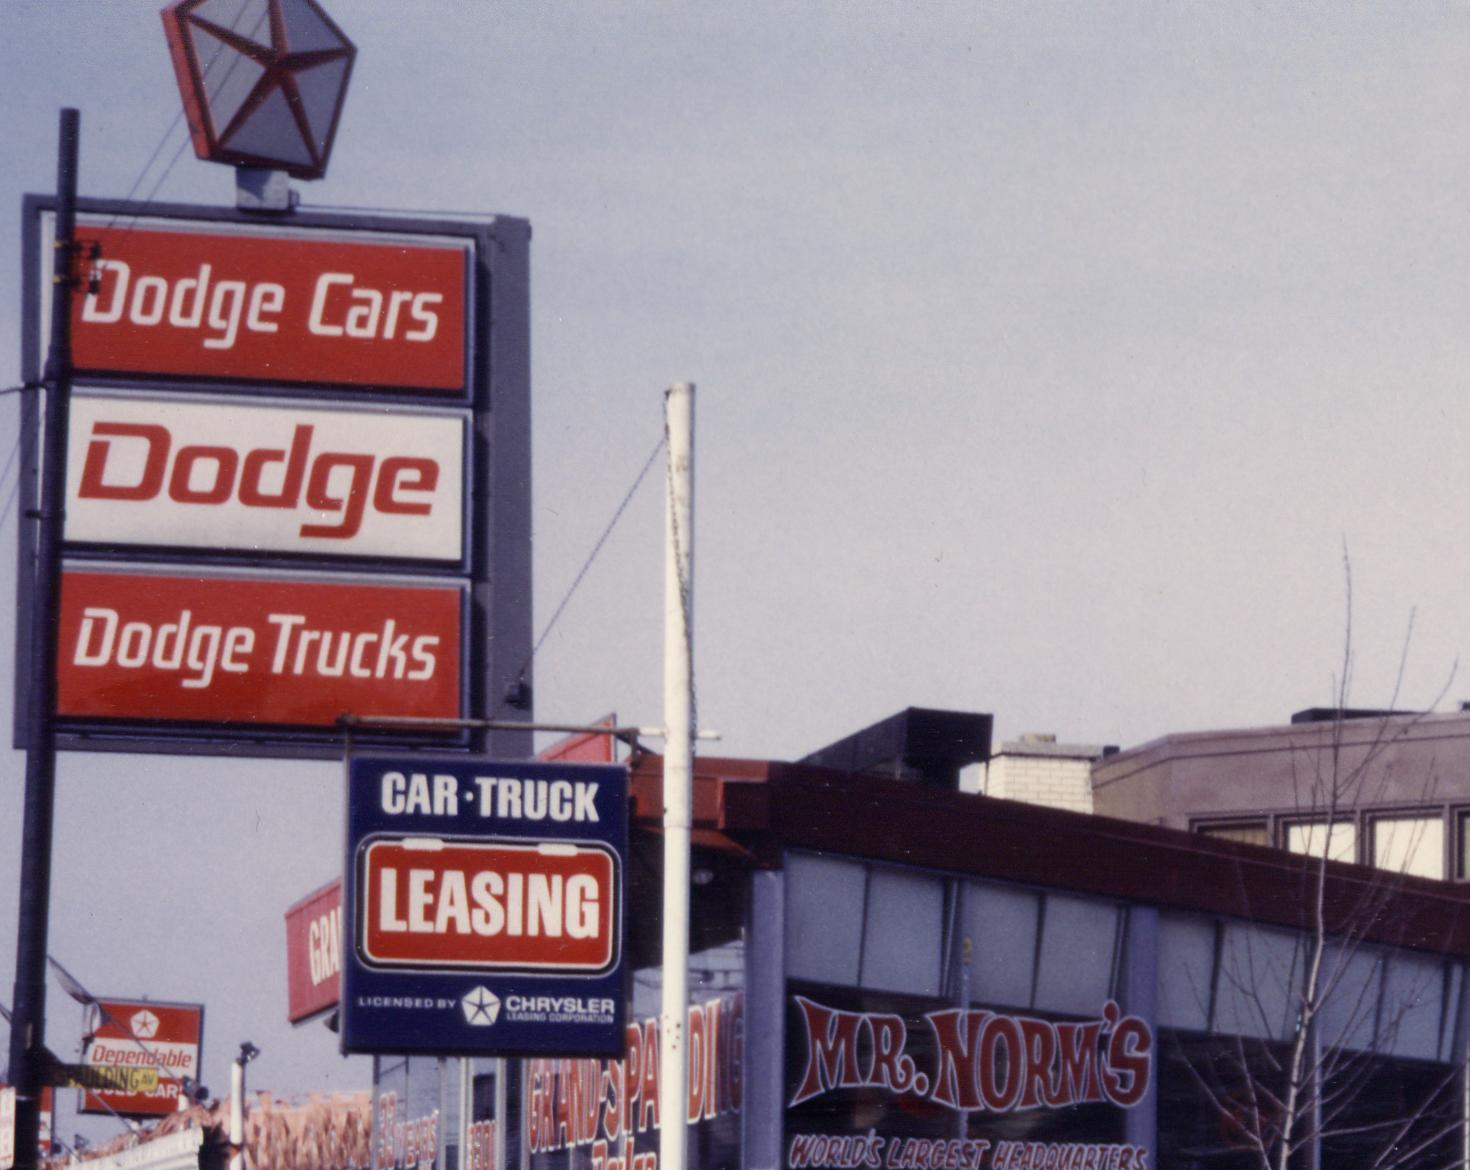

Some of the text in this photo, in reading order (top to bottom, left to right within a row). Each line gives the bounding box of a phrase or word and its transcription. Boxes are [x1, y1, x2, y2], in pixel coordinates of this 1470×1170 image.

[81, 259, 443, 349] Dodge Cars
[77, 421, 440, 539] Dodge
[73, 607, 440, 689] Dodge Trucks
[380, 867, 600, 940] LEASING
[309, 904, 342, 988] GRA
[358, 996, 457, 1009] LICENSED BY
[505, 995, 616, 1014] CHRYSLER
[506, 1012, 614, 1024] LEASING CORPORATION
[91, 1044, 192, 1068] Dependable
[787, 994, 1152, 1113] MR. NORM'S
[788, 1129, 886, 1169] WORLD'S
